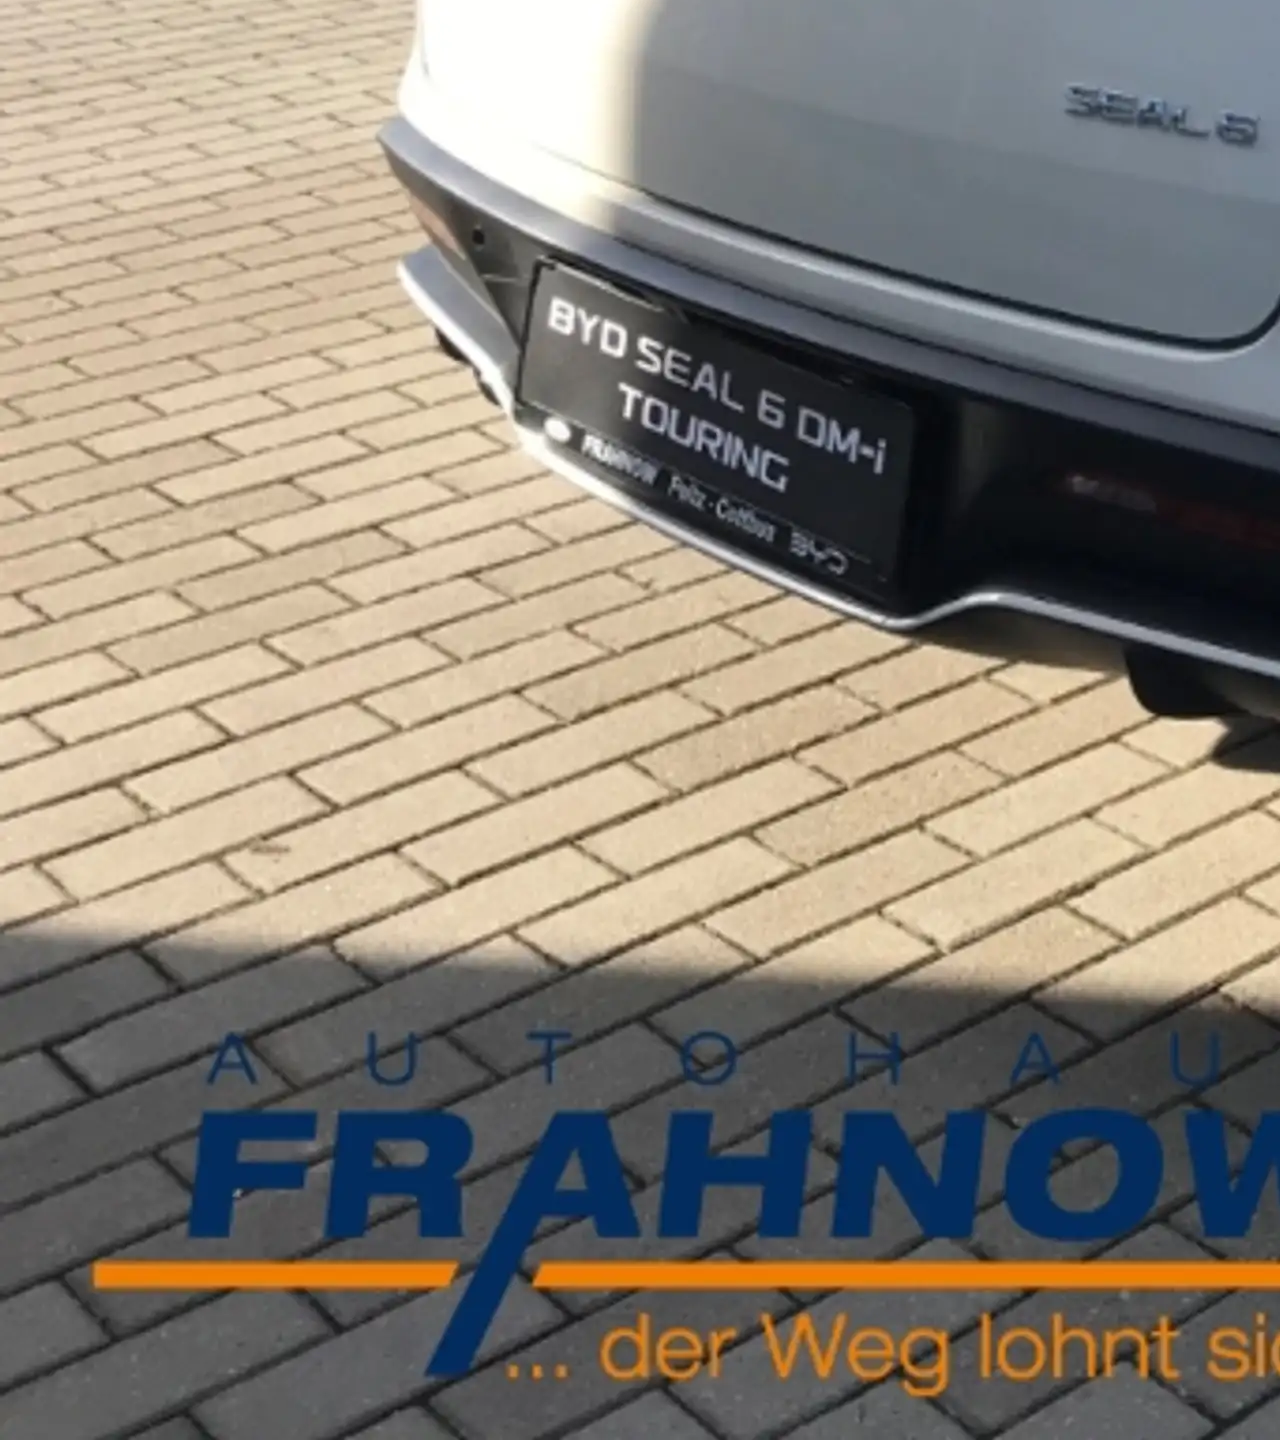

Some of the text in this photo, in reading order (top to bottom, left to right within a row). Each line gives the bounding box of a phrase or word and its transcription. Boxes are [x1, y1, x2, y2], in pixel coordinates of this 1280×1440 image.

[1064, 82, 1260, 148] SEAL 6
[547, 297, 887, 475] BYD SEAL 6 DM-i
[618, 381, 790, 494] TOURING
[789, 530, 849, 576] BYD
